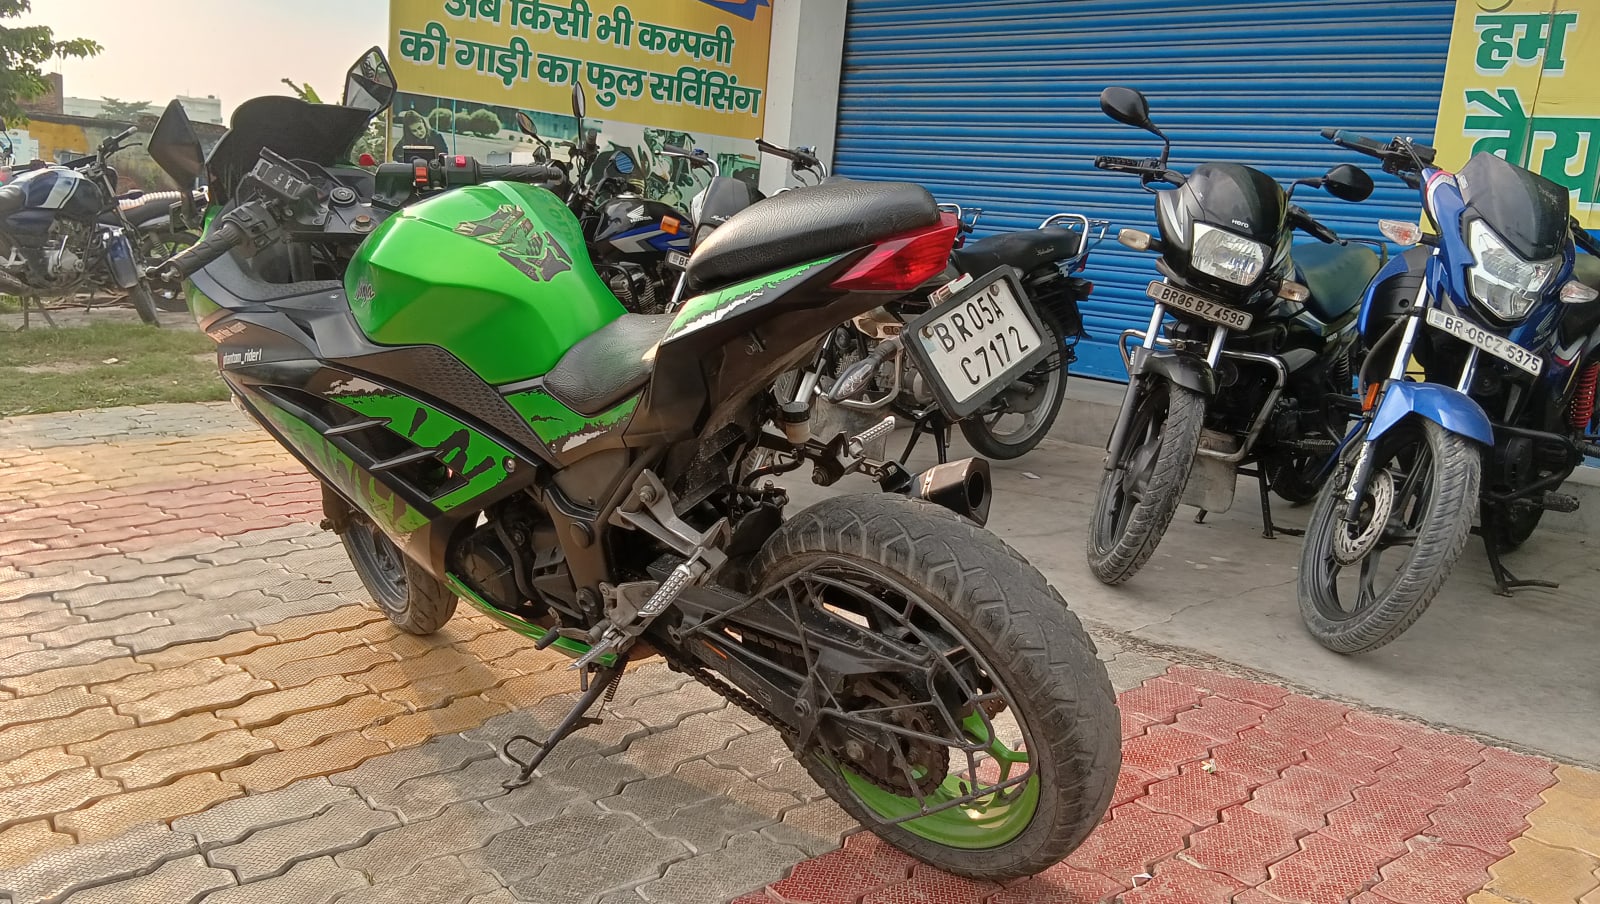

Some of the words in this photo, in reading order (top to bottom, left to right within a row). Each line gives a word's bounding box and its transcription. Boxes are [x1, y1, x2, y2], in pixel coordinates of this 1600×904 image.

[510, 0, 592, 38] किसी
[597, 6, 634, 47] भी
[638, 22, 735, 65] कम्पनी
[1475, 14, 1578, 70] हम
[400, 22, 450, 66] की
[455, 36, 533, 86] गाड़ी
[537, 53, 582, 86] का
[586, 61, 648, 108] फुल
[649, 66, 762, 115] सर्विसिंग
[960, 325, 1029, 385] C7172
[1507, 345, 1540, 371] 5375
